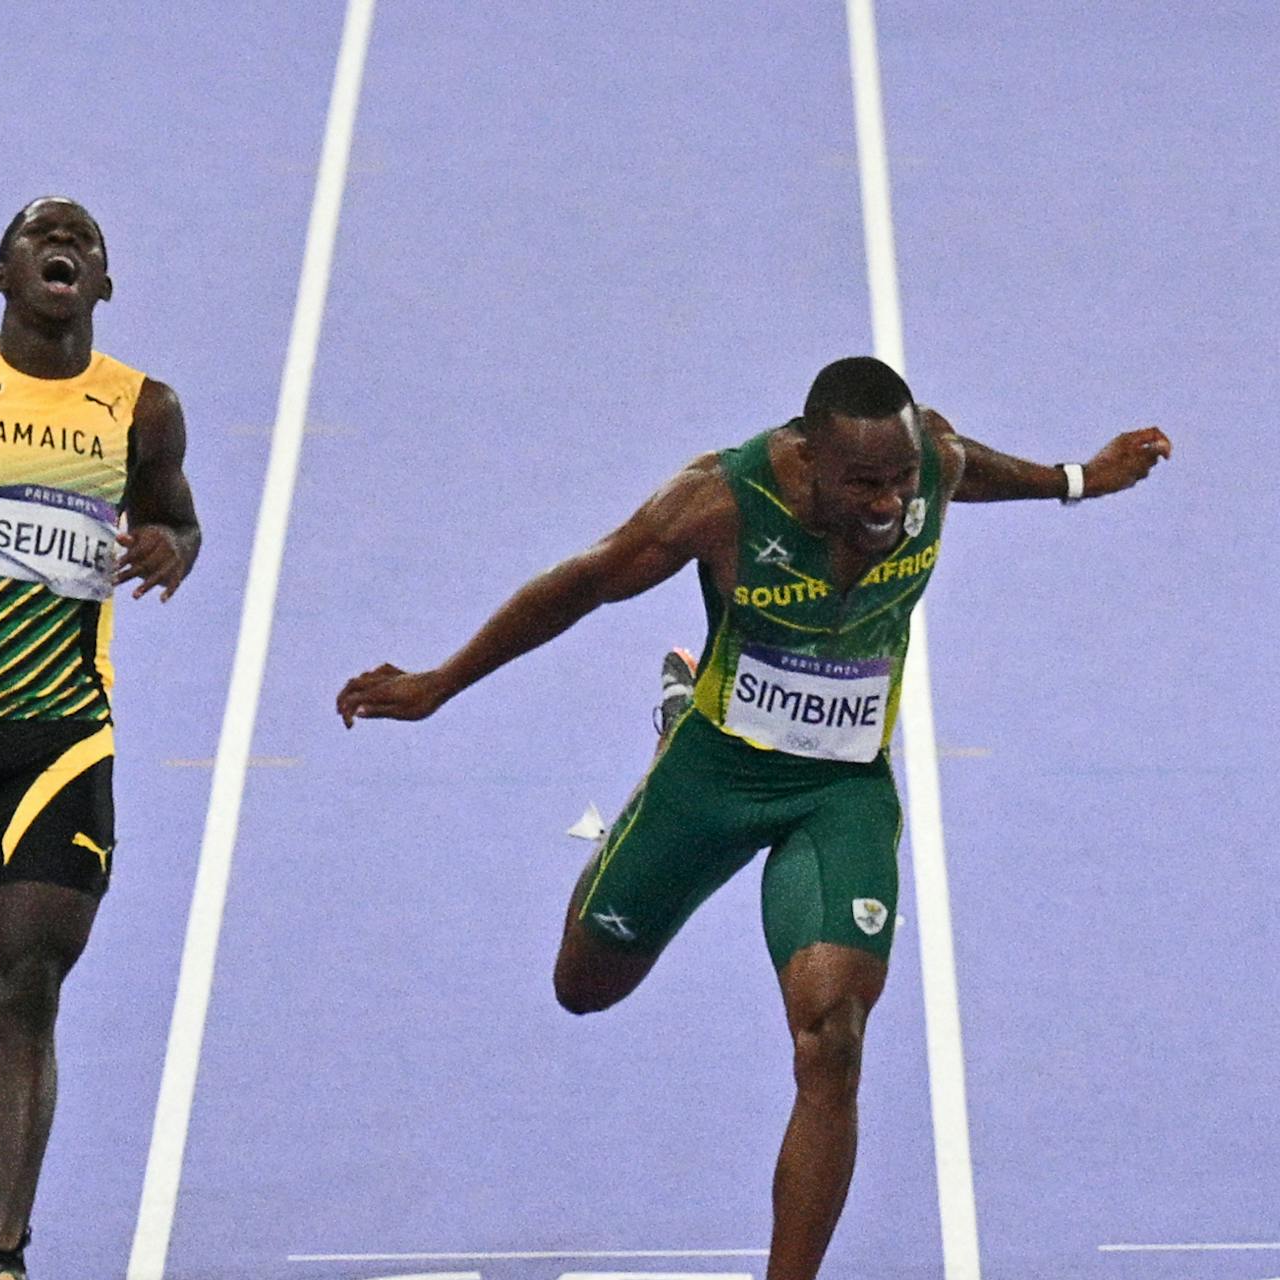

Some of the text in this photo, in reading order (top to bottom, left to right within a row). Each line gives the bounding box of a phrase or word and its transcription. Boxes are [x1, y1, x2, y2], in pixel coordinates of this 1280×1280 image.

[24, 487, 64, 504] PARIS
[734, 578, 830, 607] SOUTH
[781, 655, 860, 676] PARIS 2024
[736, 672, 880, 728] SIMBINE
